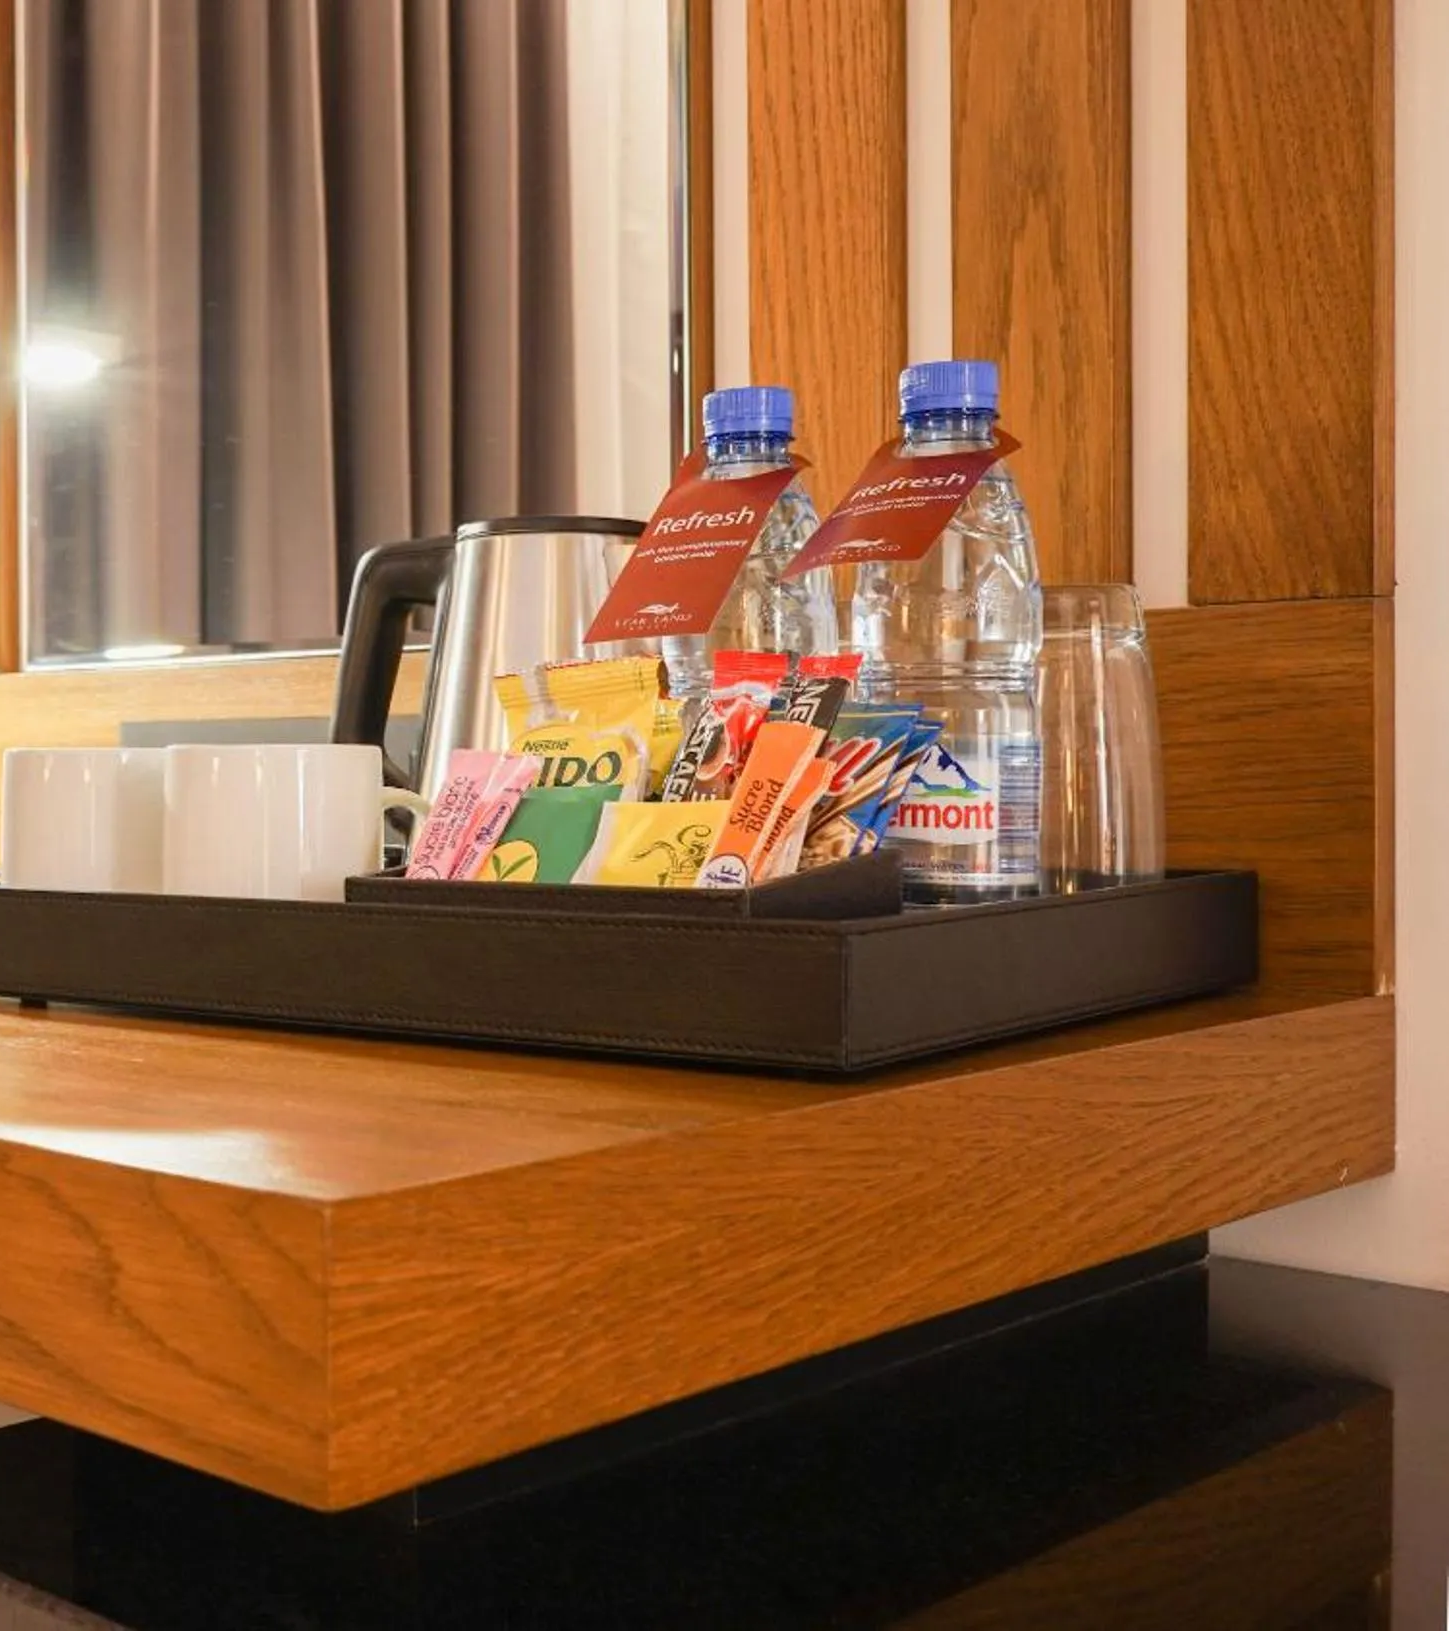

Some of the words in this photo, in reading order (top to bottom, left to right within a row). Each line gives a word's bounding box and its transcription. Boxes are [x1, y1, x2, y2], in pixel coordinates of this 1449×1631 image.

[850, 473, 966, 501] Refresh
[653, 506, 755, 536] Refresh
[536, 751, 622, 788] IDO
[730, 779, 764, 831] Sucre
[745, 778, 784, 833] Blond
